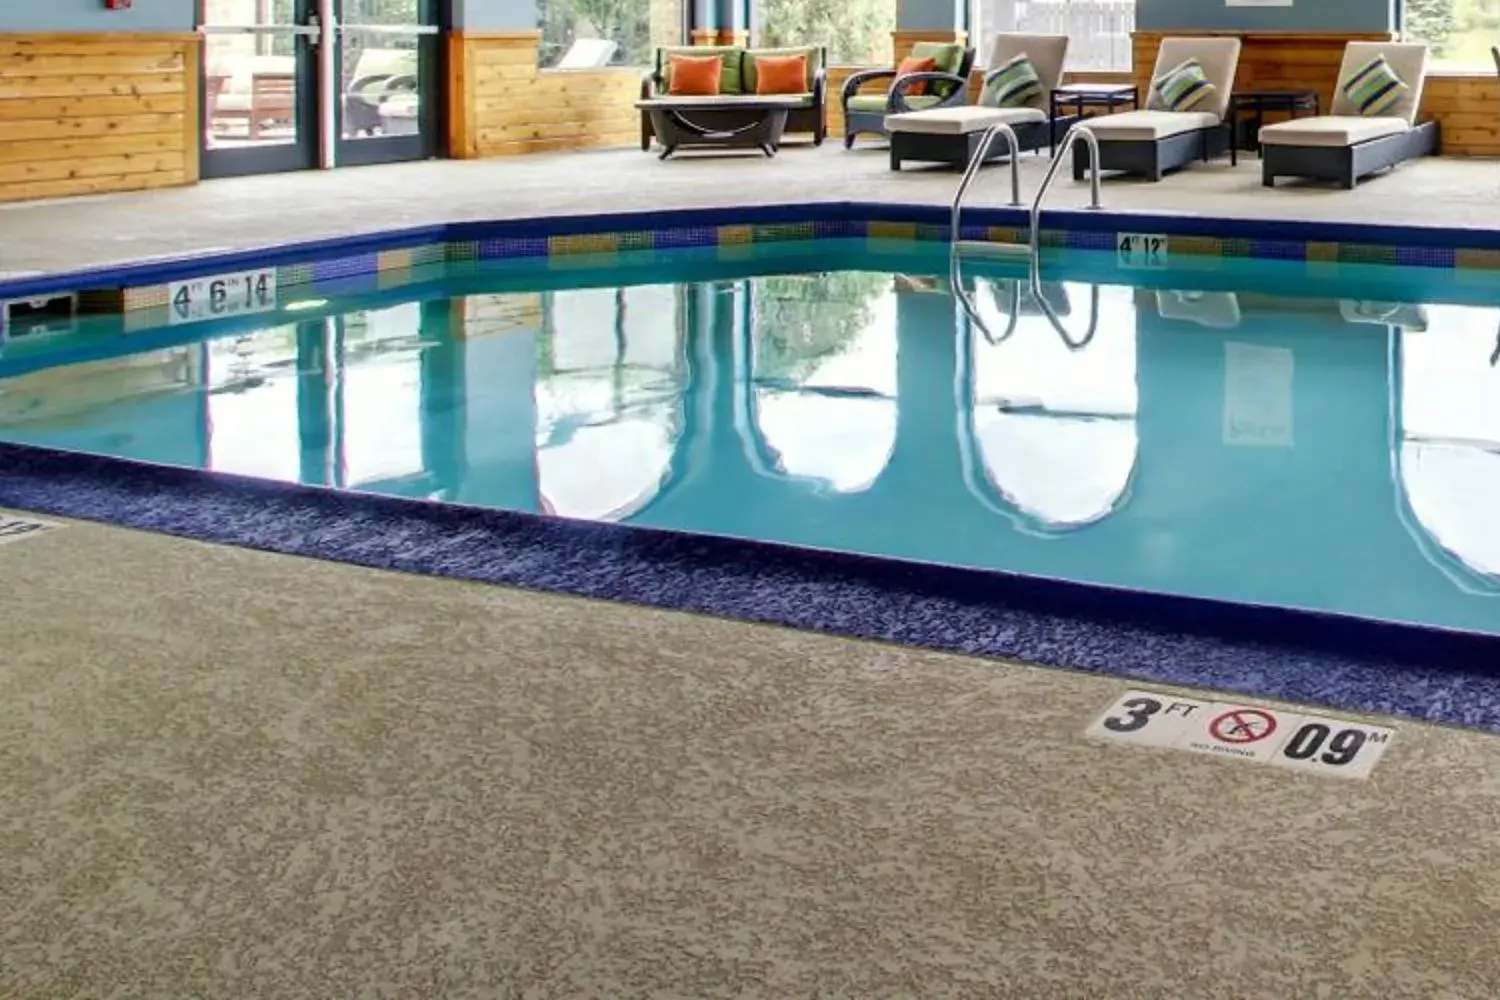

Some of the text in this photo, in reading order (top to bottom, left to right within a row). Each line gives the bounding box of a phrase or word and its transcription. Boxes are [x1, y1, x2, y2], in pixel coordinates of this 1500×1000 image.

[1120, 236, 1132, 251] 4
[174, 285, 191, 304] 4
[210, 280, 226, 302] 6
[1103, 698, 1162, 733] 3
[1164, 702, 1199, 717] FT
[1368, 731, 1389, 744] M
